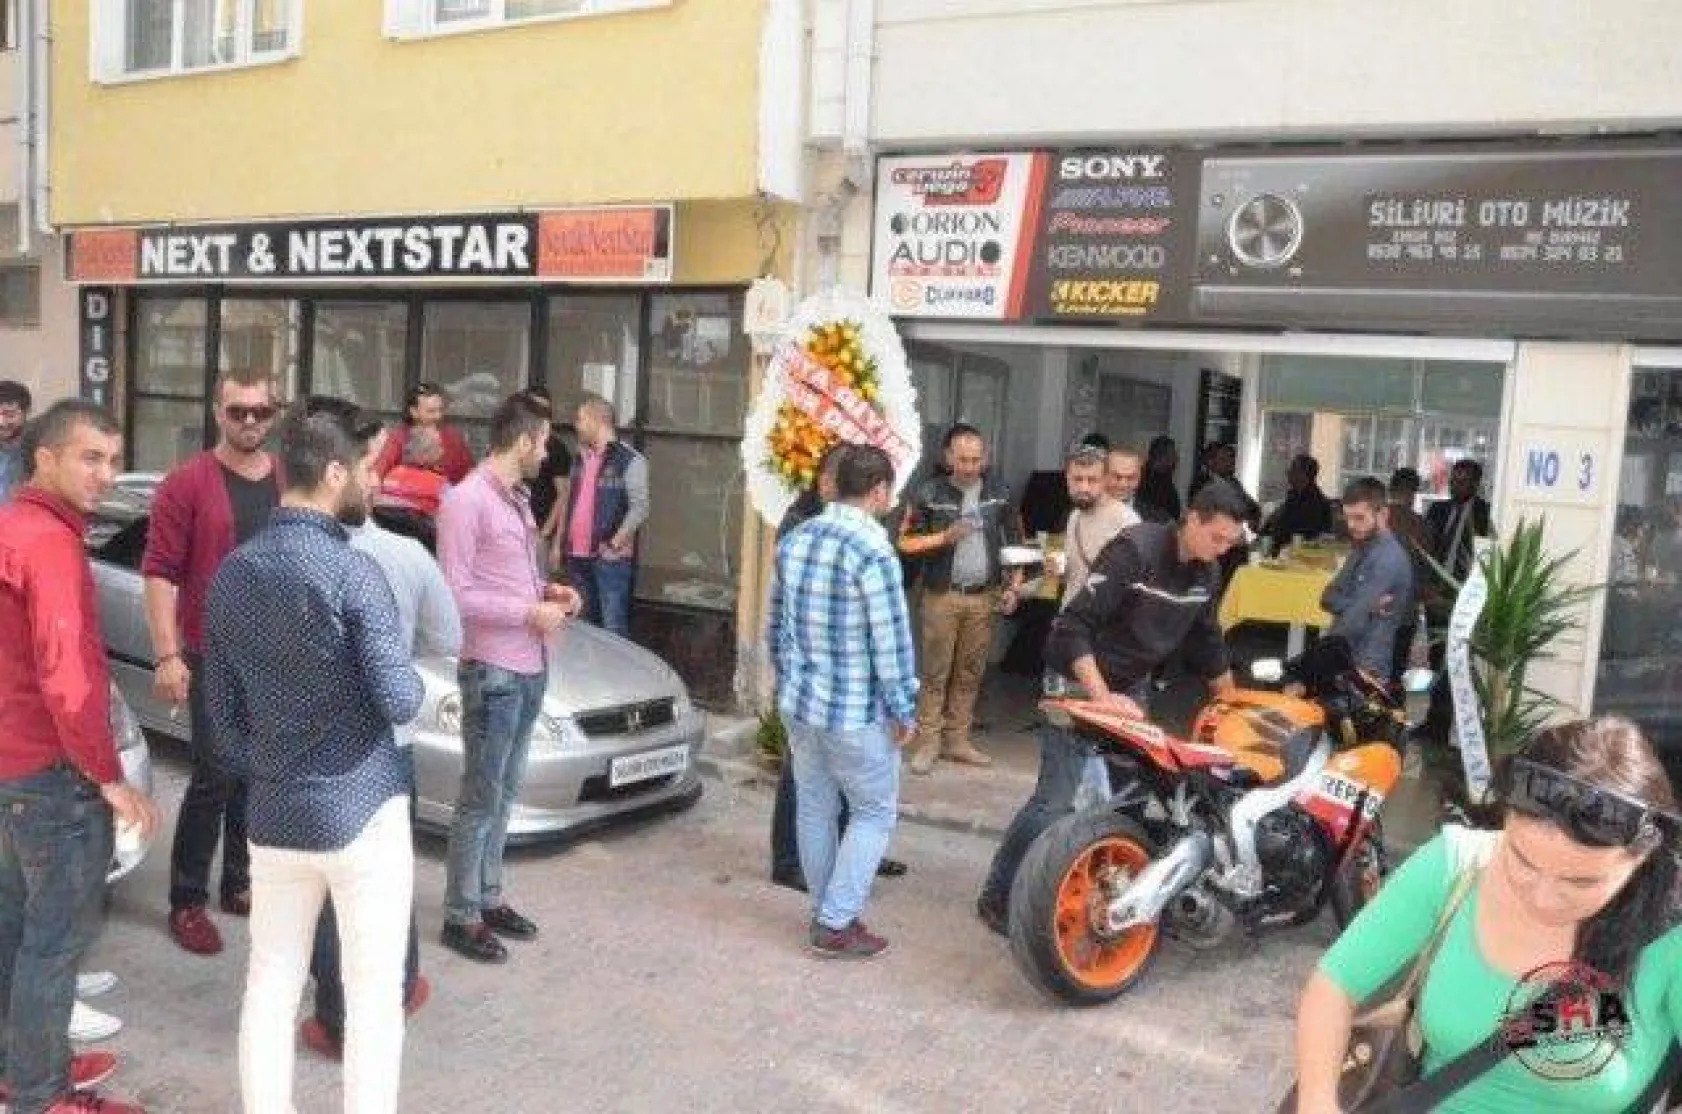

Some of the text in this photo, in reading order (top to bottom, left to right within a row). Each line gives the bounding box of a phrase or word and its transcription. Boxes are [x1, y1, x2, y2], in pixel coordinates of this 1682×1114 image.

[911, 211, 1001, 235] ORION
[1479, 200, 1528, 226] OTO
[141, 233, 237, 274] NEXT
[247, 233, 276, 273] &
[288, 223, 530, 273] NEXTSTAR
[1068, 280, 1161, 304] KICKER
[1526, 450, 1592, 490] NO 3
